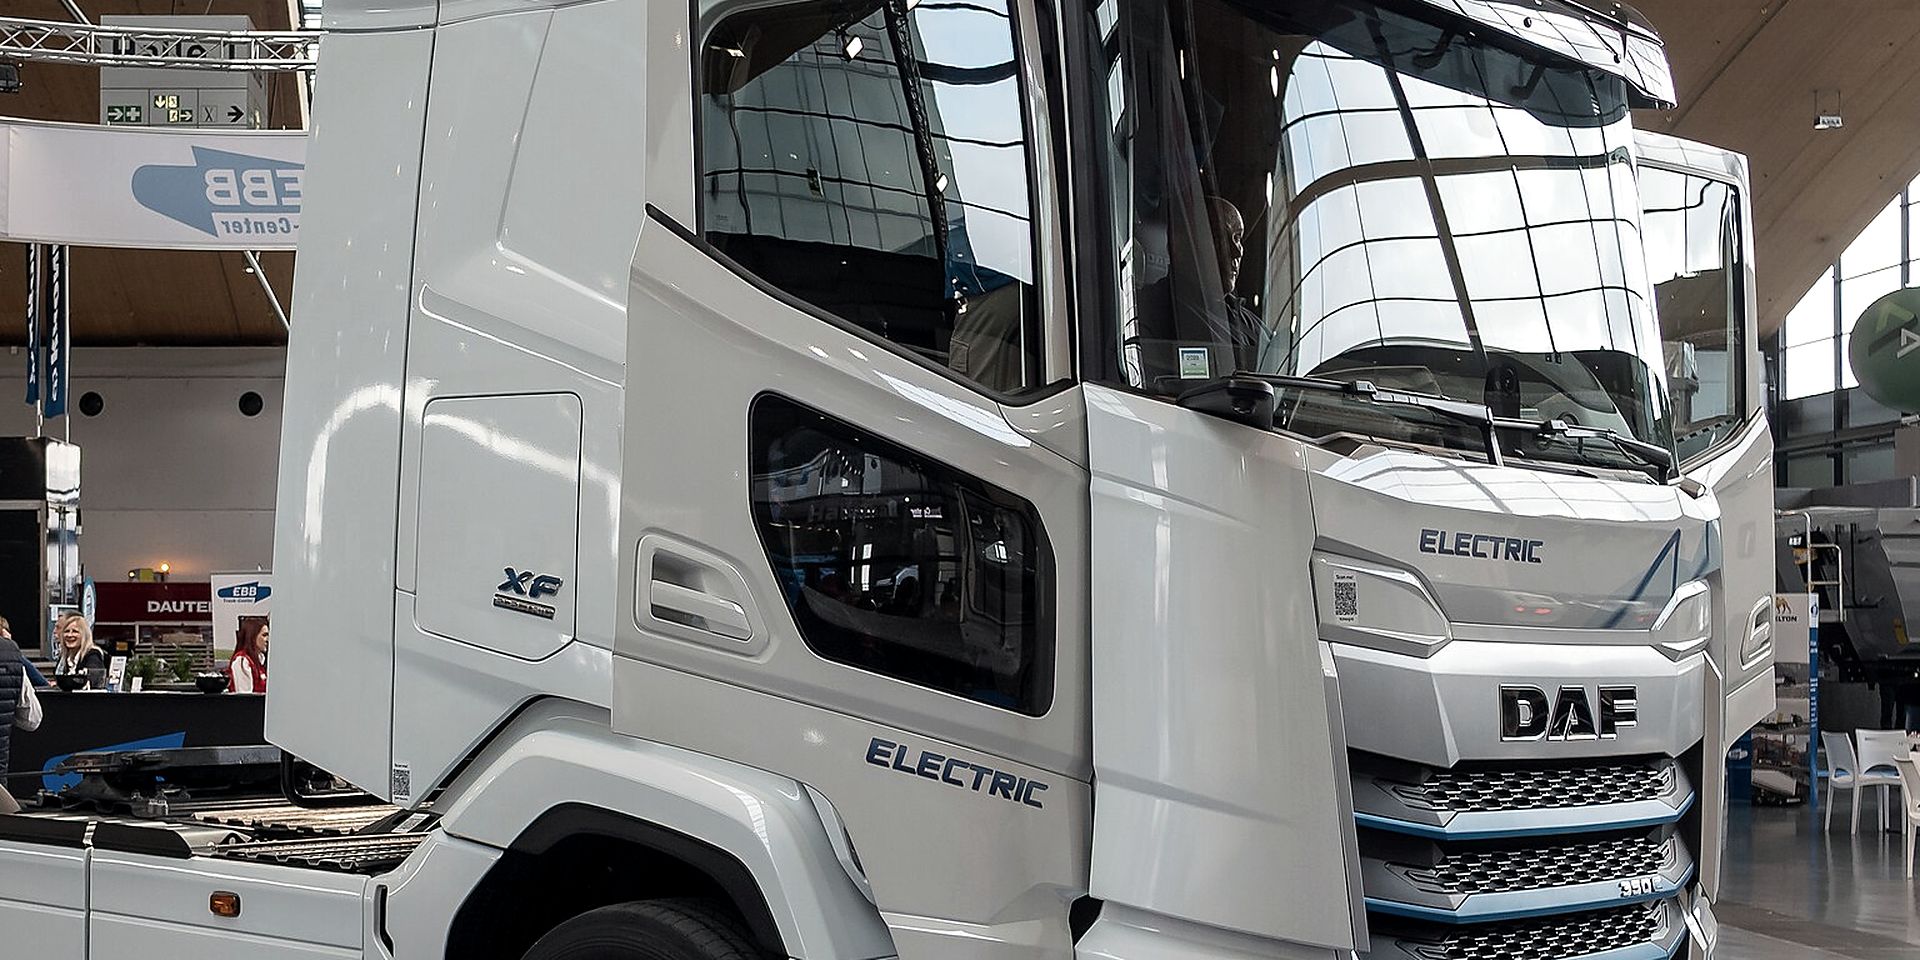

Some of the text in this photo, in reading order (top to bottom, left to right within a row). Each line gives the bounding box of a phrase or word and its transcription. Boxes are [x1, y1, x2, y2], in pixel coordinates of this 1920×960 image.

[1419, 528, 1544, 564] ELECTRIC
[232, 586, 257, 597] EBB
[496, 566, 563, 599] XF
[1499, 684, 1638, 741] DAF
[865, 737, 1049, 809] ELECTRIC
